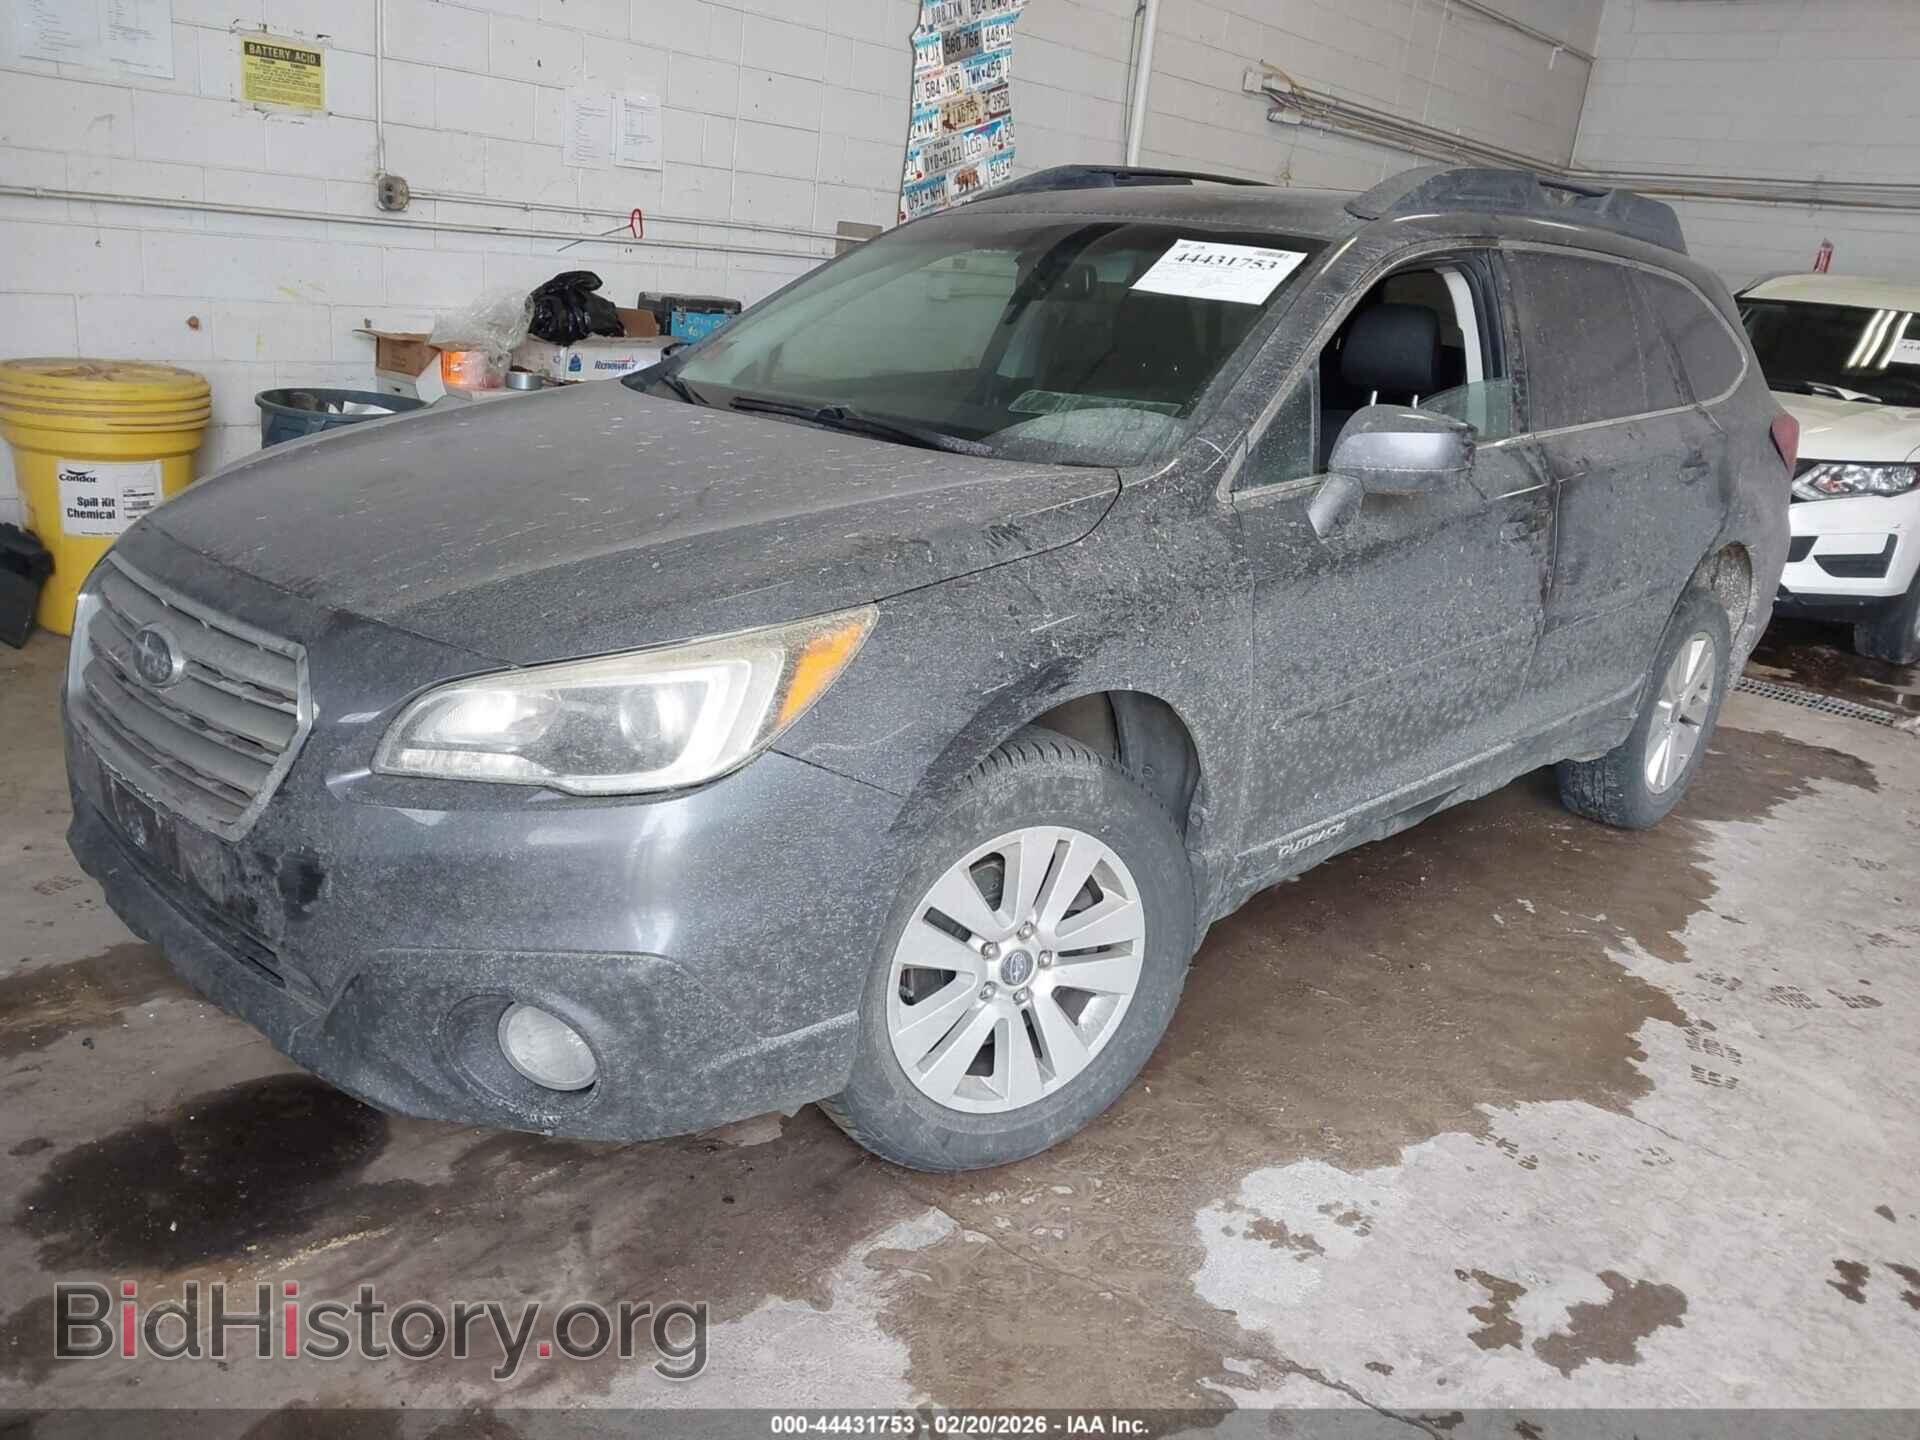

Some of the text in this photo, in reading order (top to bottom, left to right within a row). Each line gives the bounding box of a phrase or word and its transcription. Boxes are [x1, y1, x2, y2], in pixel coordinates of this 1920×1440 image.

[248, 43, 317, 64] BATTERY ACID
[1174, 252, 1278, 271] 44431753
[58, 473, 97, 483] Condor
[76, 496, 116, 508] Spill Kit
[66, 507, 116, 519] Chemical
